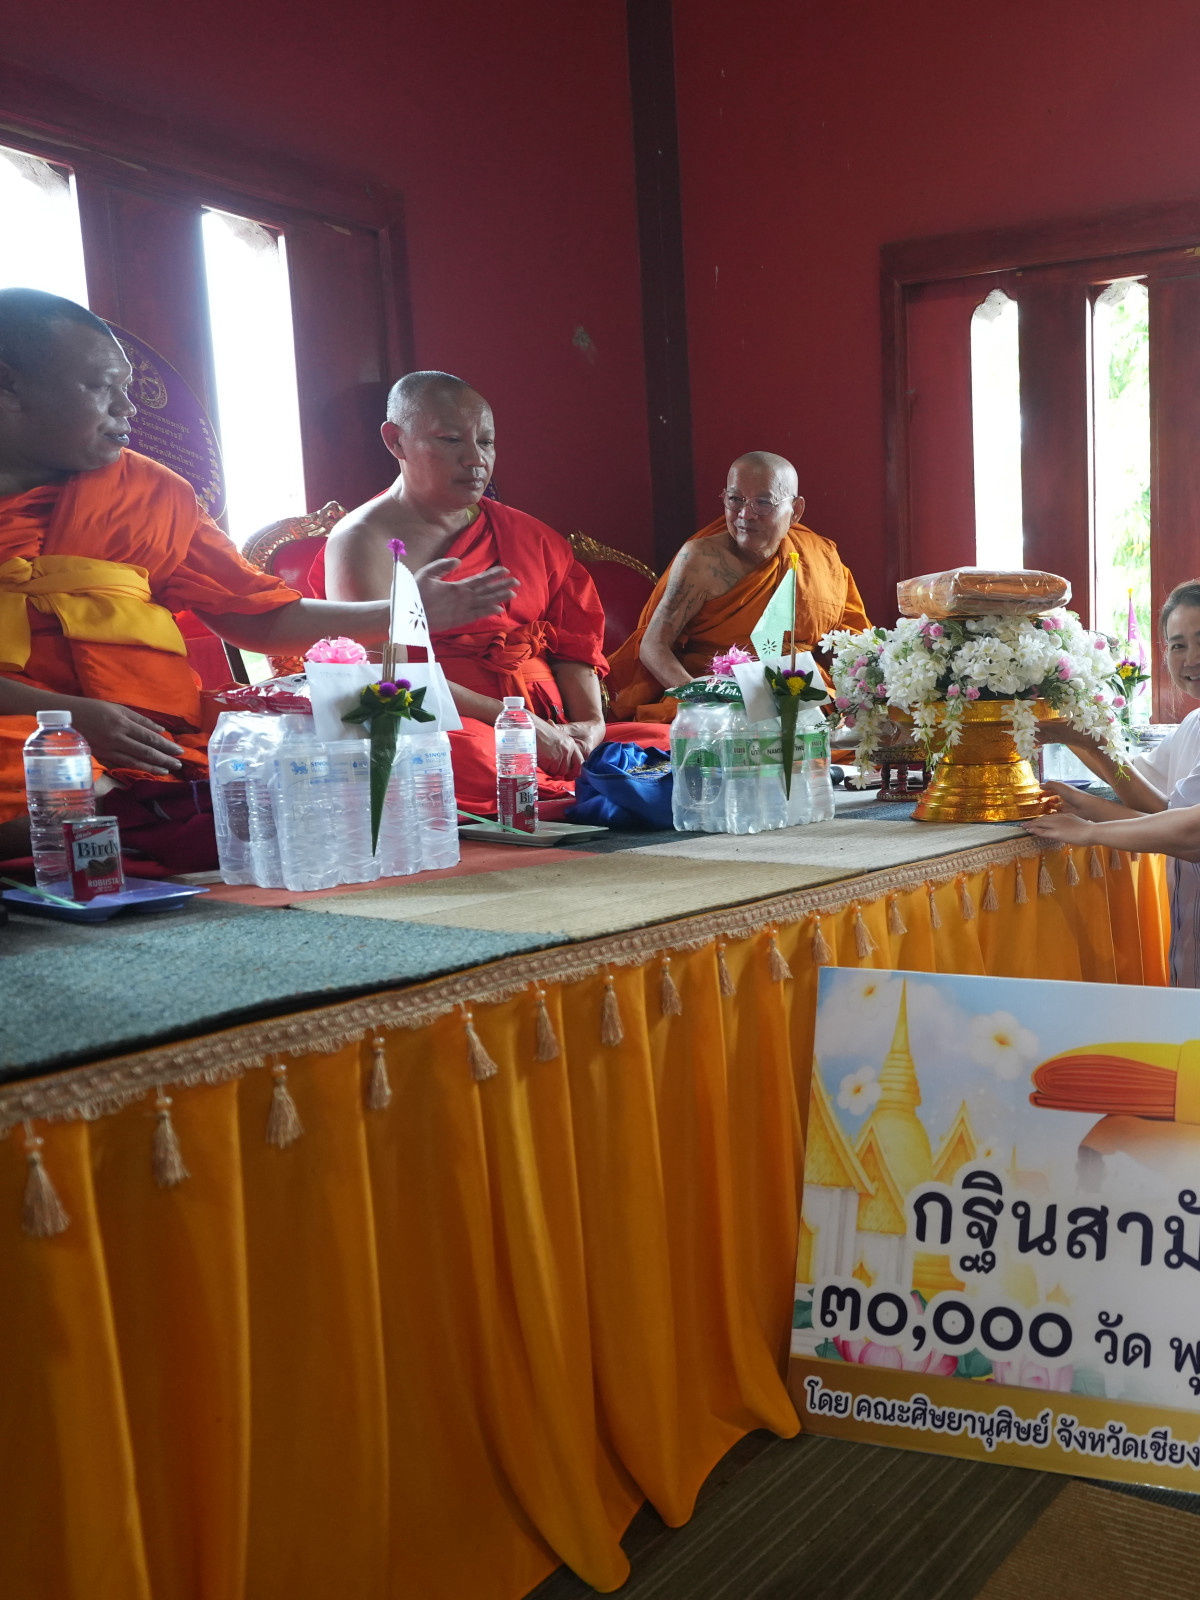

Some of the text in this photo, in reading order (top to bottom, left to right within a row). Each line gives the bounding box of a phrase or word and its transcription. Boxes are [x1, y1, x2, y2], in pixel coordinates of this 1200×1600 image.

[87, 877, 119, 888] ROBUSTA
[819, 1284, 1073, 1358] ๓๐,๐๐๐
[1094, 1310, 1152, 1369] วัด
[805, 1380, 849, 1415] โดย
[855, 1397, 1050, 1449] คณะศิษยานุศิษย์
